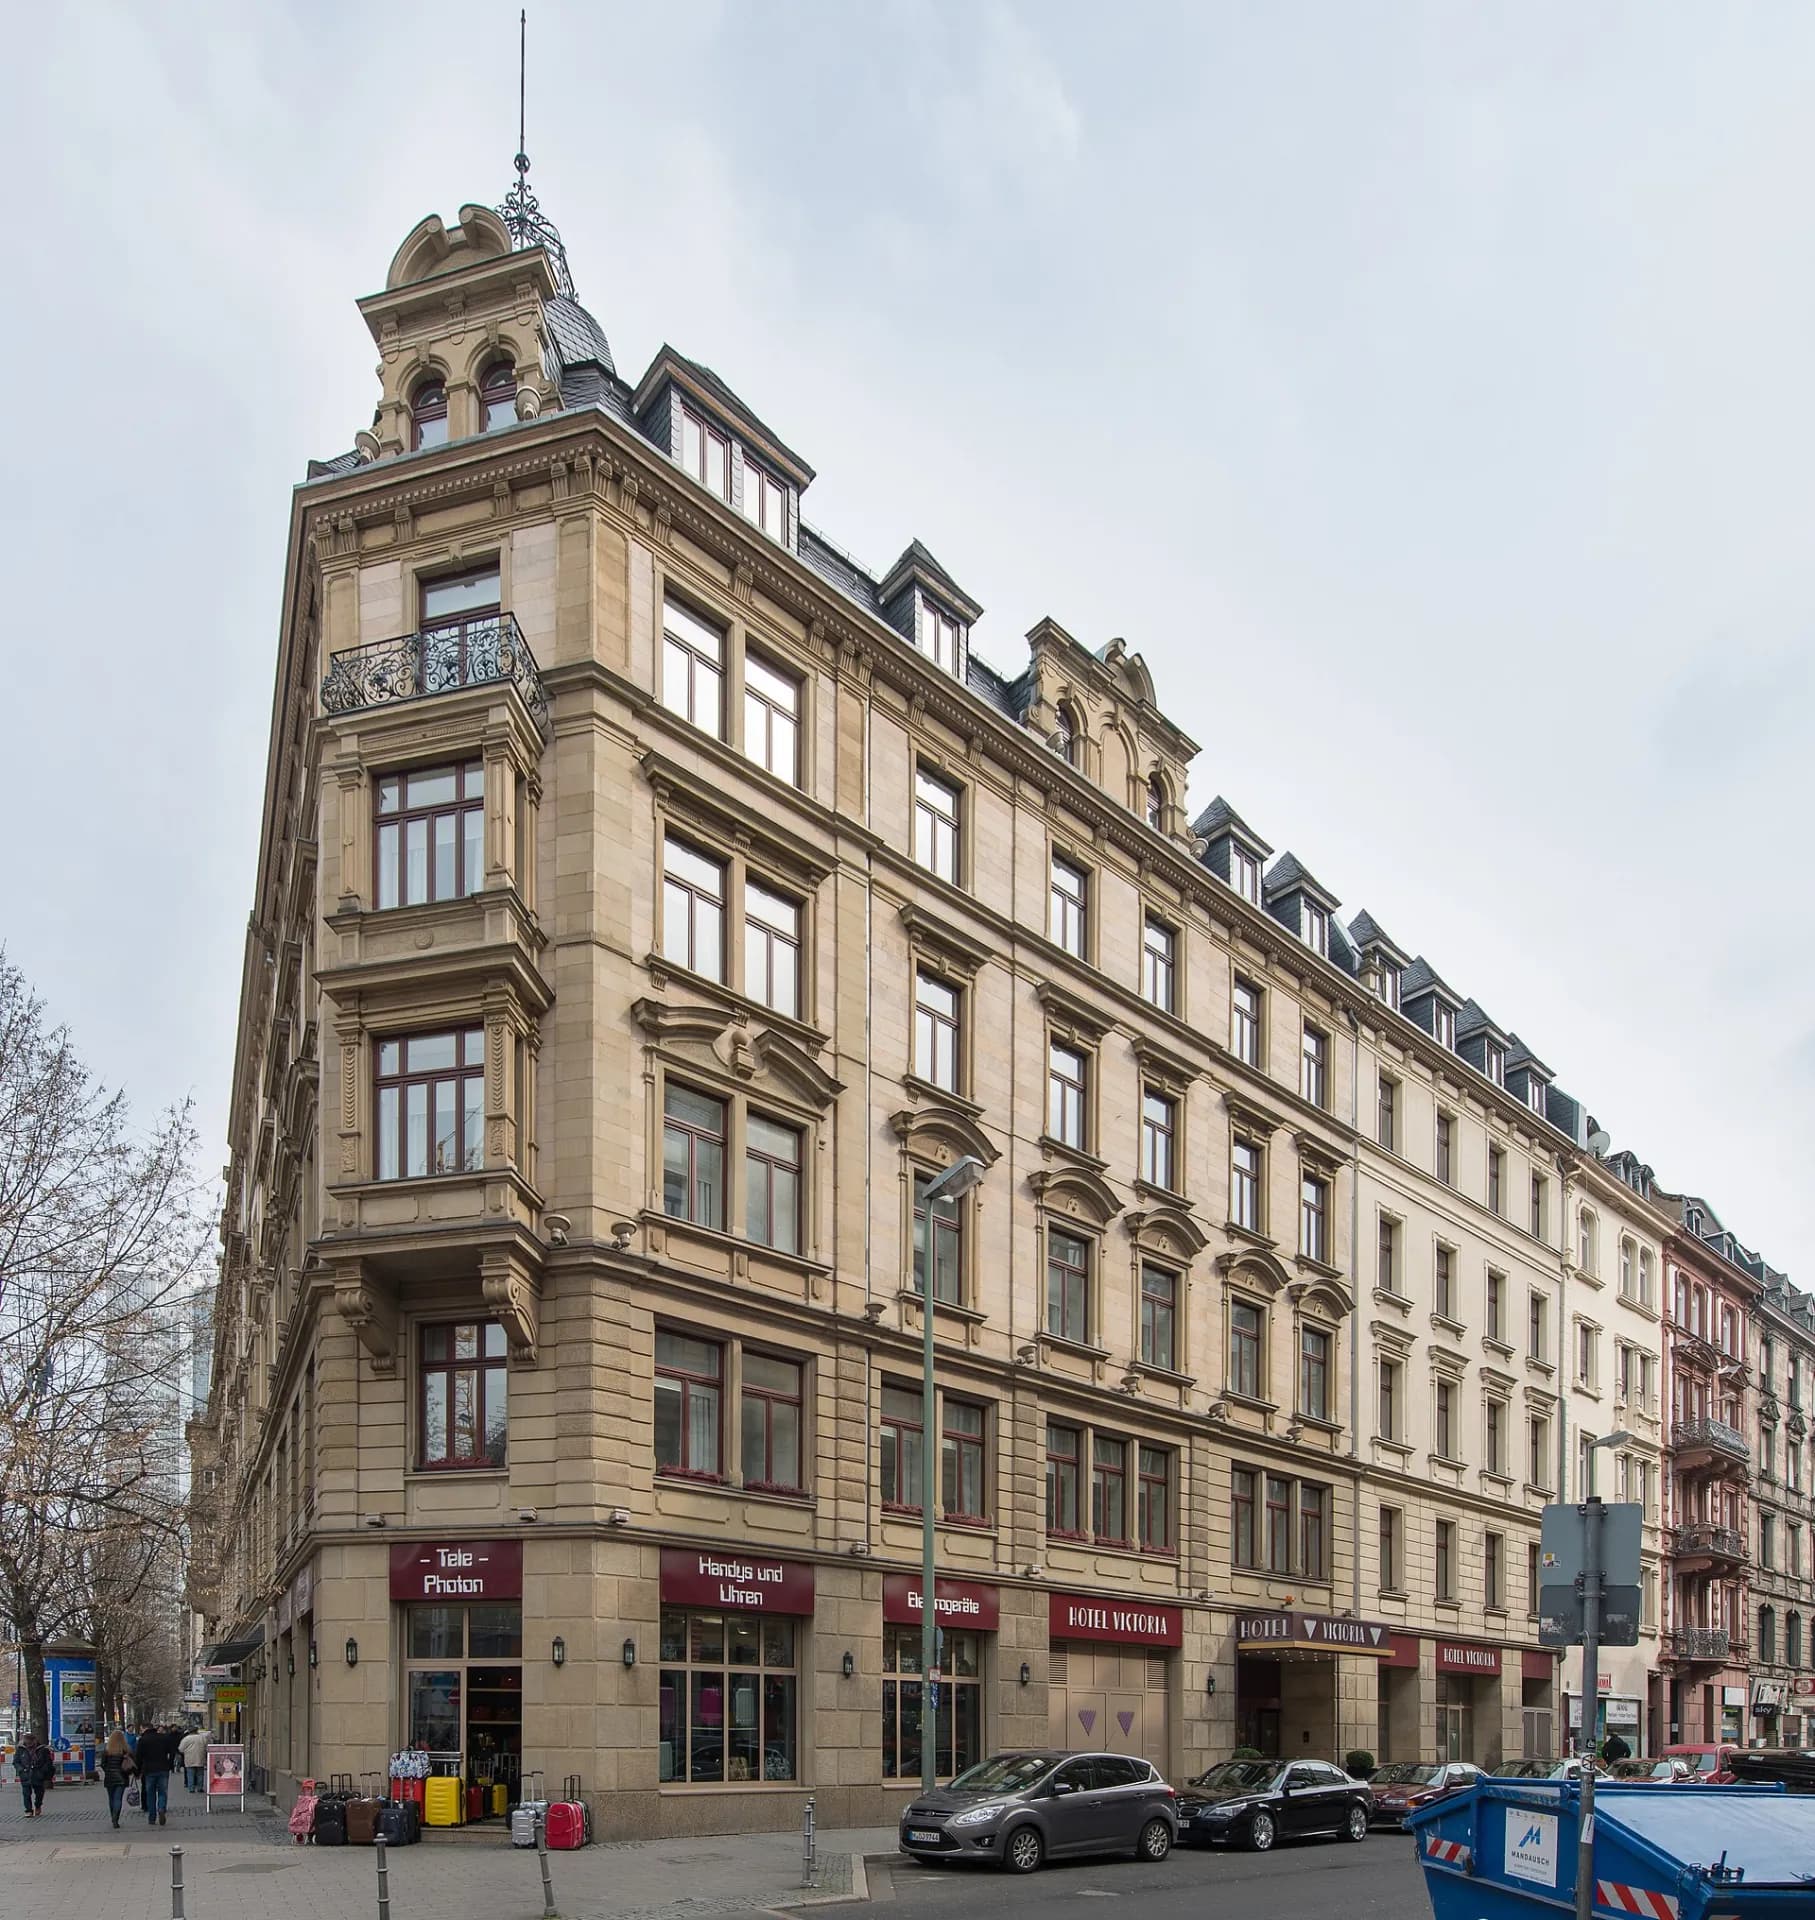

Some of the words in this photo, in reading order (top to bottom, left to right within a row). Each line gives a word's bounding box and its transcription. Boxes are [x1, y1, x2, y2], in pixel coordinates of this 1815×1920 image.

[436, 1548, 473, 1568] Tele
[698, 1556, 753, 1583] Handys
[757, 1565, 783, 1583] und
[423, 1575, 484, 1594] Photon
[720, 1583, 763, 1606] Uhren
[1068, 1606, 1109, 1630] HOTEL
[1113, 1611, 1168, 1636] VICTORIA
[1240, 1618, 1291, 1639] HOTEL
[1322, 1621, 1366, 1644] VICTORIA
[1443, 1647, 1465, 1665] HOTEL
[1465, 1650, 1496, 1667] VICTORIA
[1754, 1706, 1773, 1715] sky
[1511, 1850, 1551, 1867] MANDAUSCH
